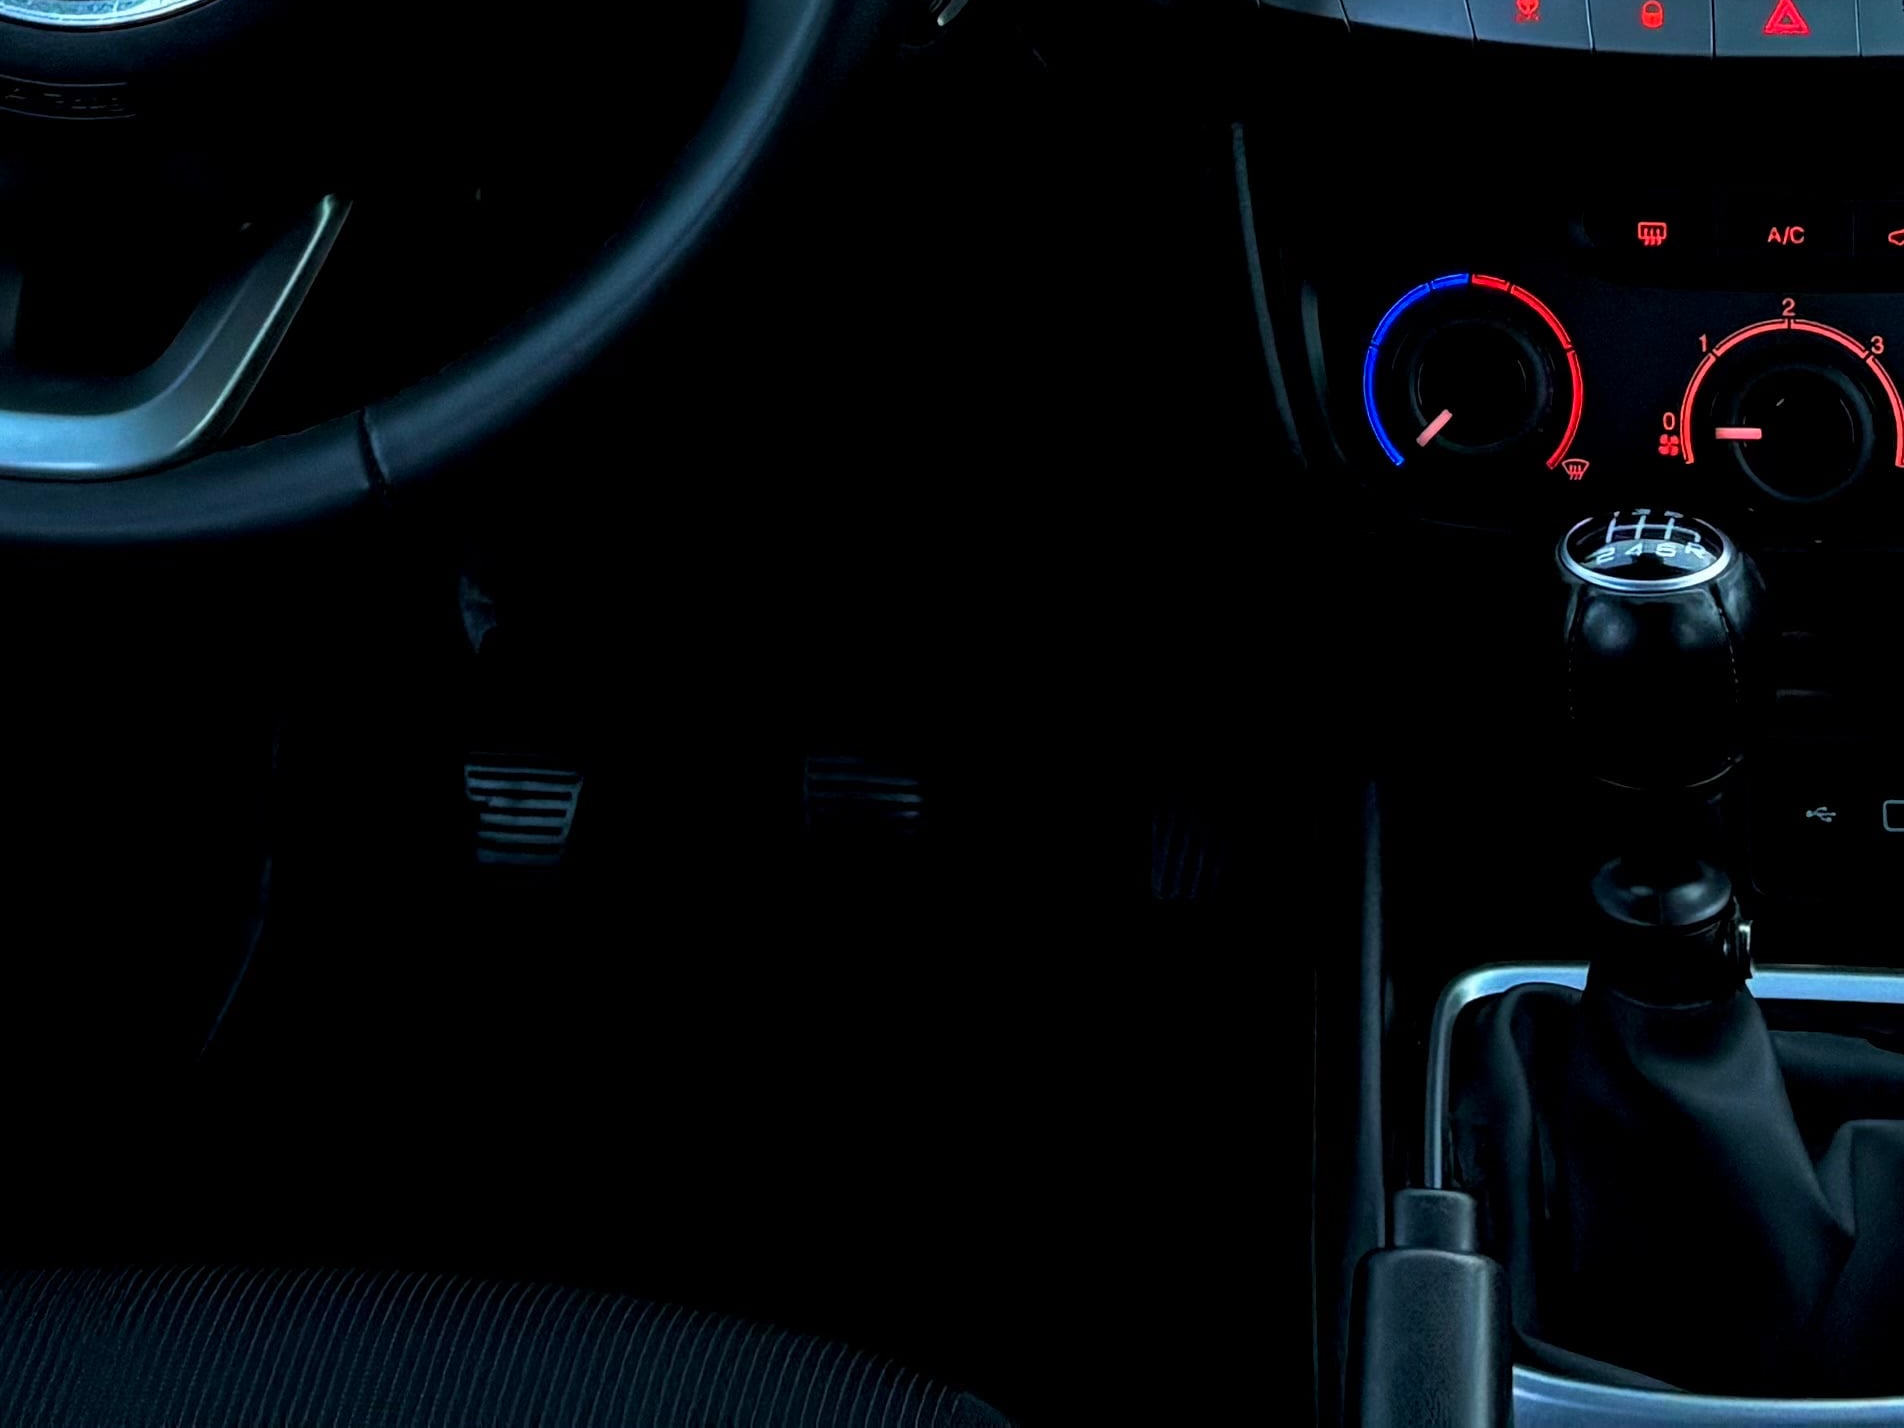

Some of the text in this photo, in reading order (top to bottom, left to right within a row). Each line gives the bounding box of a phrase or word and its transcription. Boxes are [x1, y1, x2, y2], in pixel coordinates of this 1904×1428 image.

[1768, 226, 1805, 244] A/C
[1782, 298, 1795, 316] 2
[1698, 333, 1707, 352] 1
[1870, 336, 1884, 354] 3
[1662, 411, 1675, 430] 0
[1596, 546, 1615, 563] 2
[1625, 542, 1643, 556] 4
[1685, 542, 1707, 559] R
